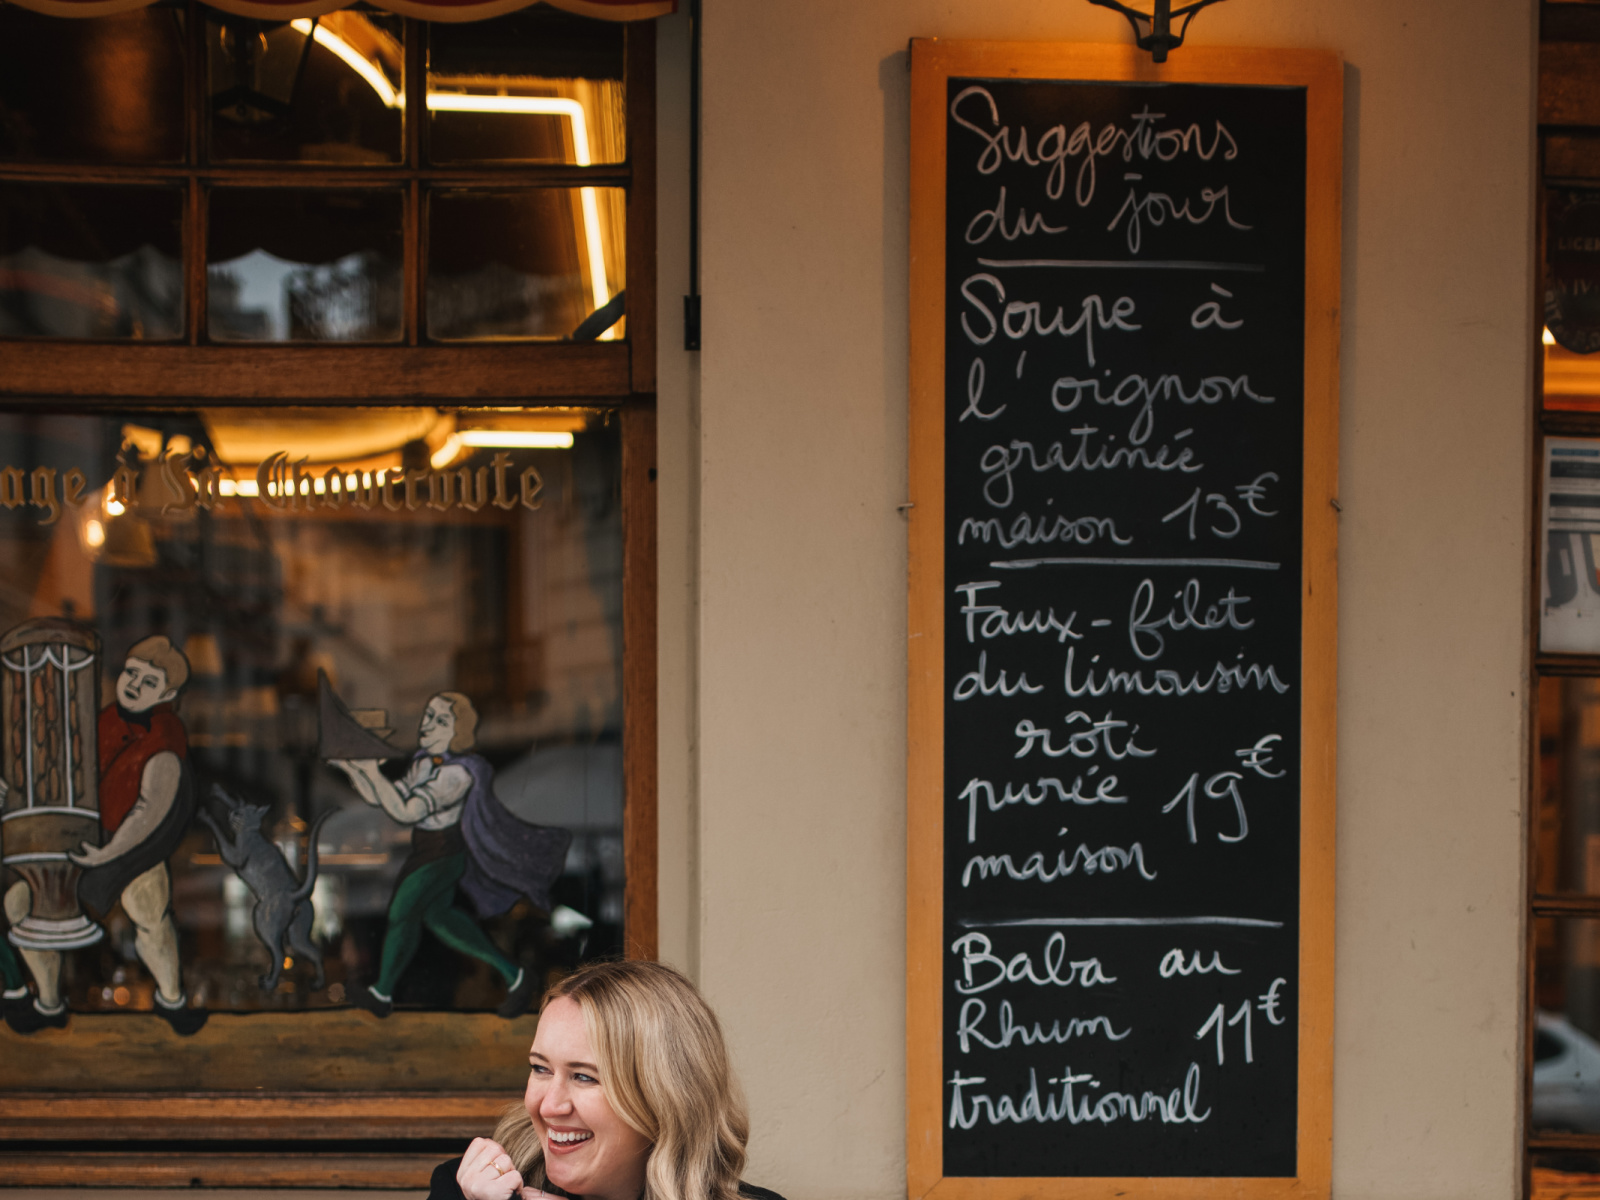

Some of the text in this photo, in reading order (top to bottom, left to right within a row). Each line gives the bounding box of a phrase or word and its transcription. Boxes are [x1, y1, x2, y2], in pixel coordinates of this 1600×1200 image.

[950, 85, 1238, 207] Suggestions
[965, 173, 1253, 254] du jour
[960, 272, 1244, 367] Soupe à
[256, 449, 545, 513] Choucroute
[980, 424, 1203, 508] gratinée
[958, 498, 1133, 550] maison
[953, 649, 1045, 702] du
[1014, 710, 1158, 761] rôti
[957, 764, 1129, 844] purée
[961, 826, 1158, 888] maison
[950, 931, 1242, 996] Baba au
[955, 998, 1132, 1055] Rhum
[947, 1061, 1213, 1131] traditionnel
